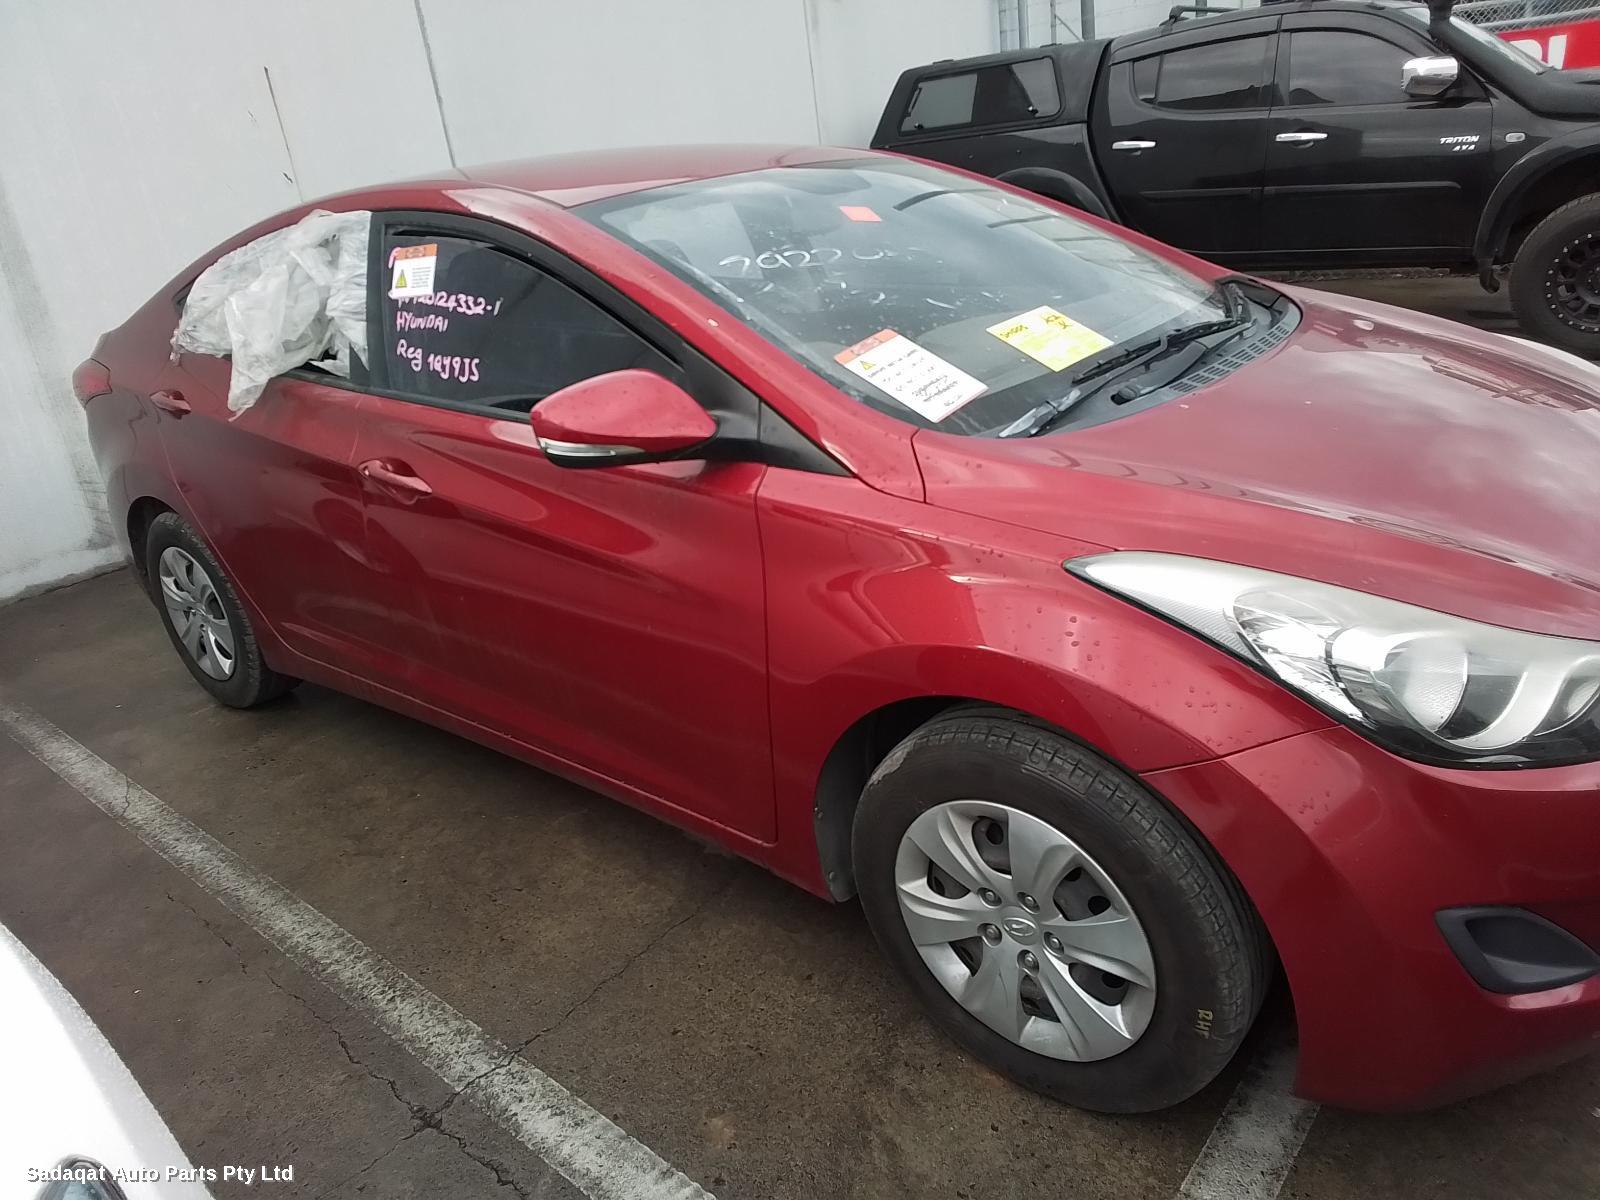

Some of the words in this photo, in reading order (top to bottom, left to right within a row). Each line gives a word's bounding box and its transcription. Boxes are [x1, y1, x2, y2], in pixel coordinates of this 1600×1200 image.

[1440, 135, 1480, 144] TRITON
[396, 311, 448, 332] HYUNDAI
[396, 339, 423, 371] Reg
